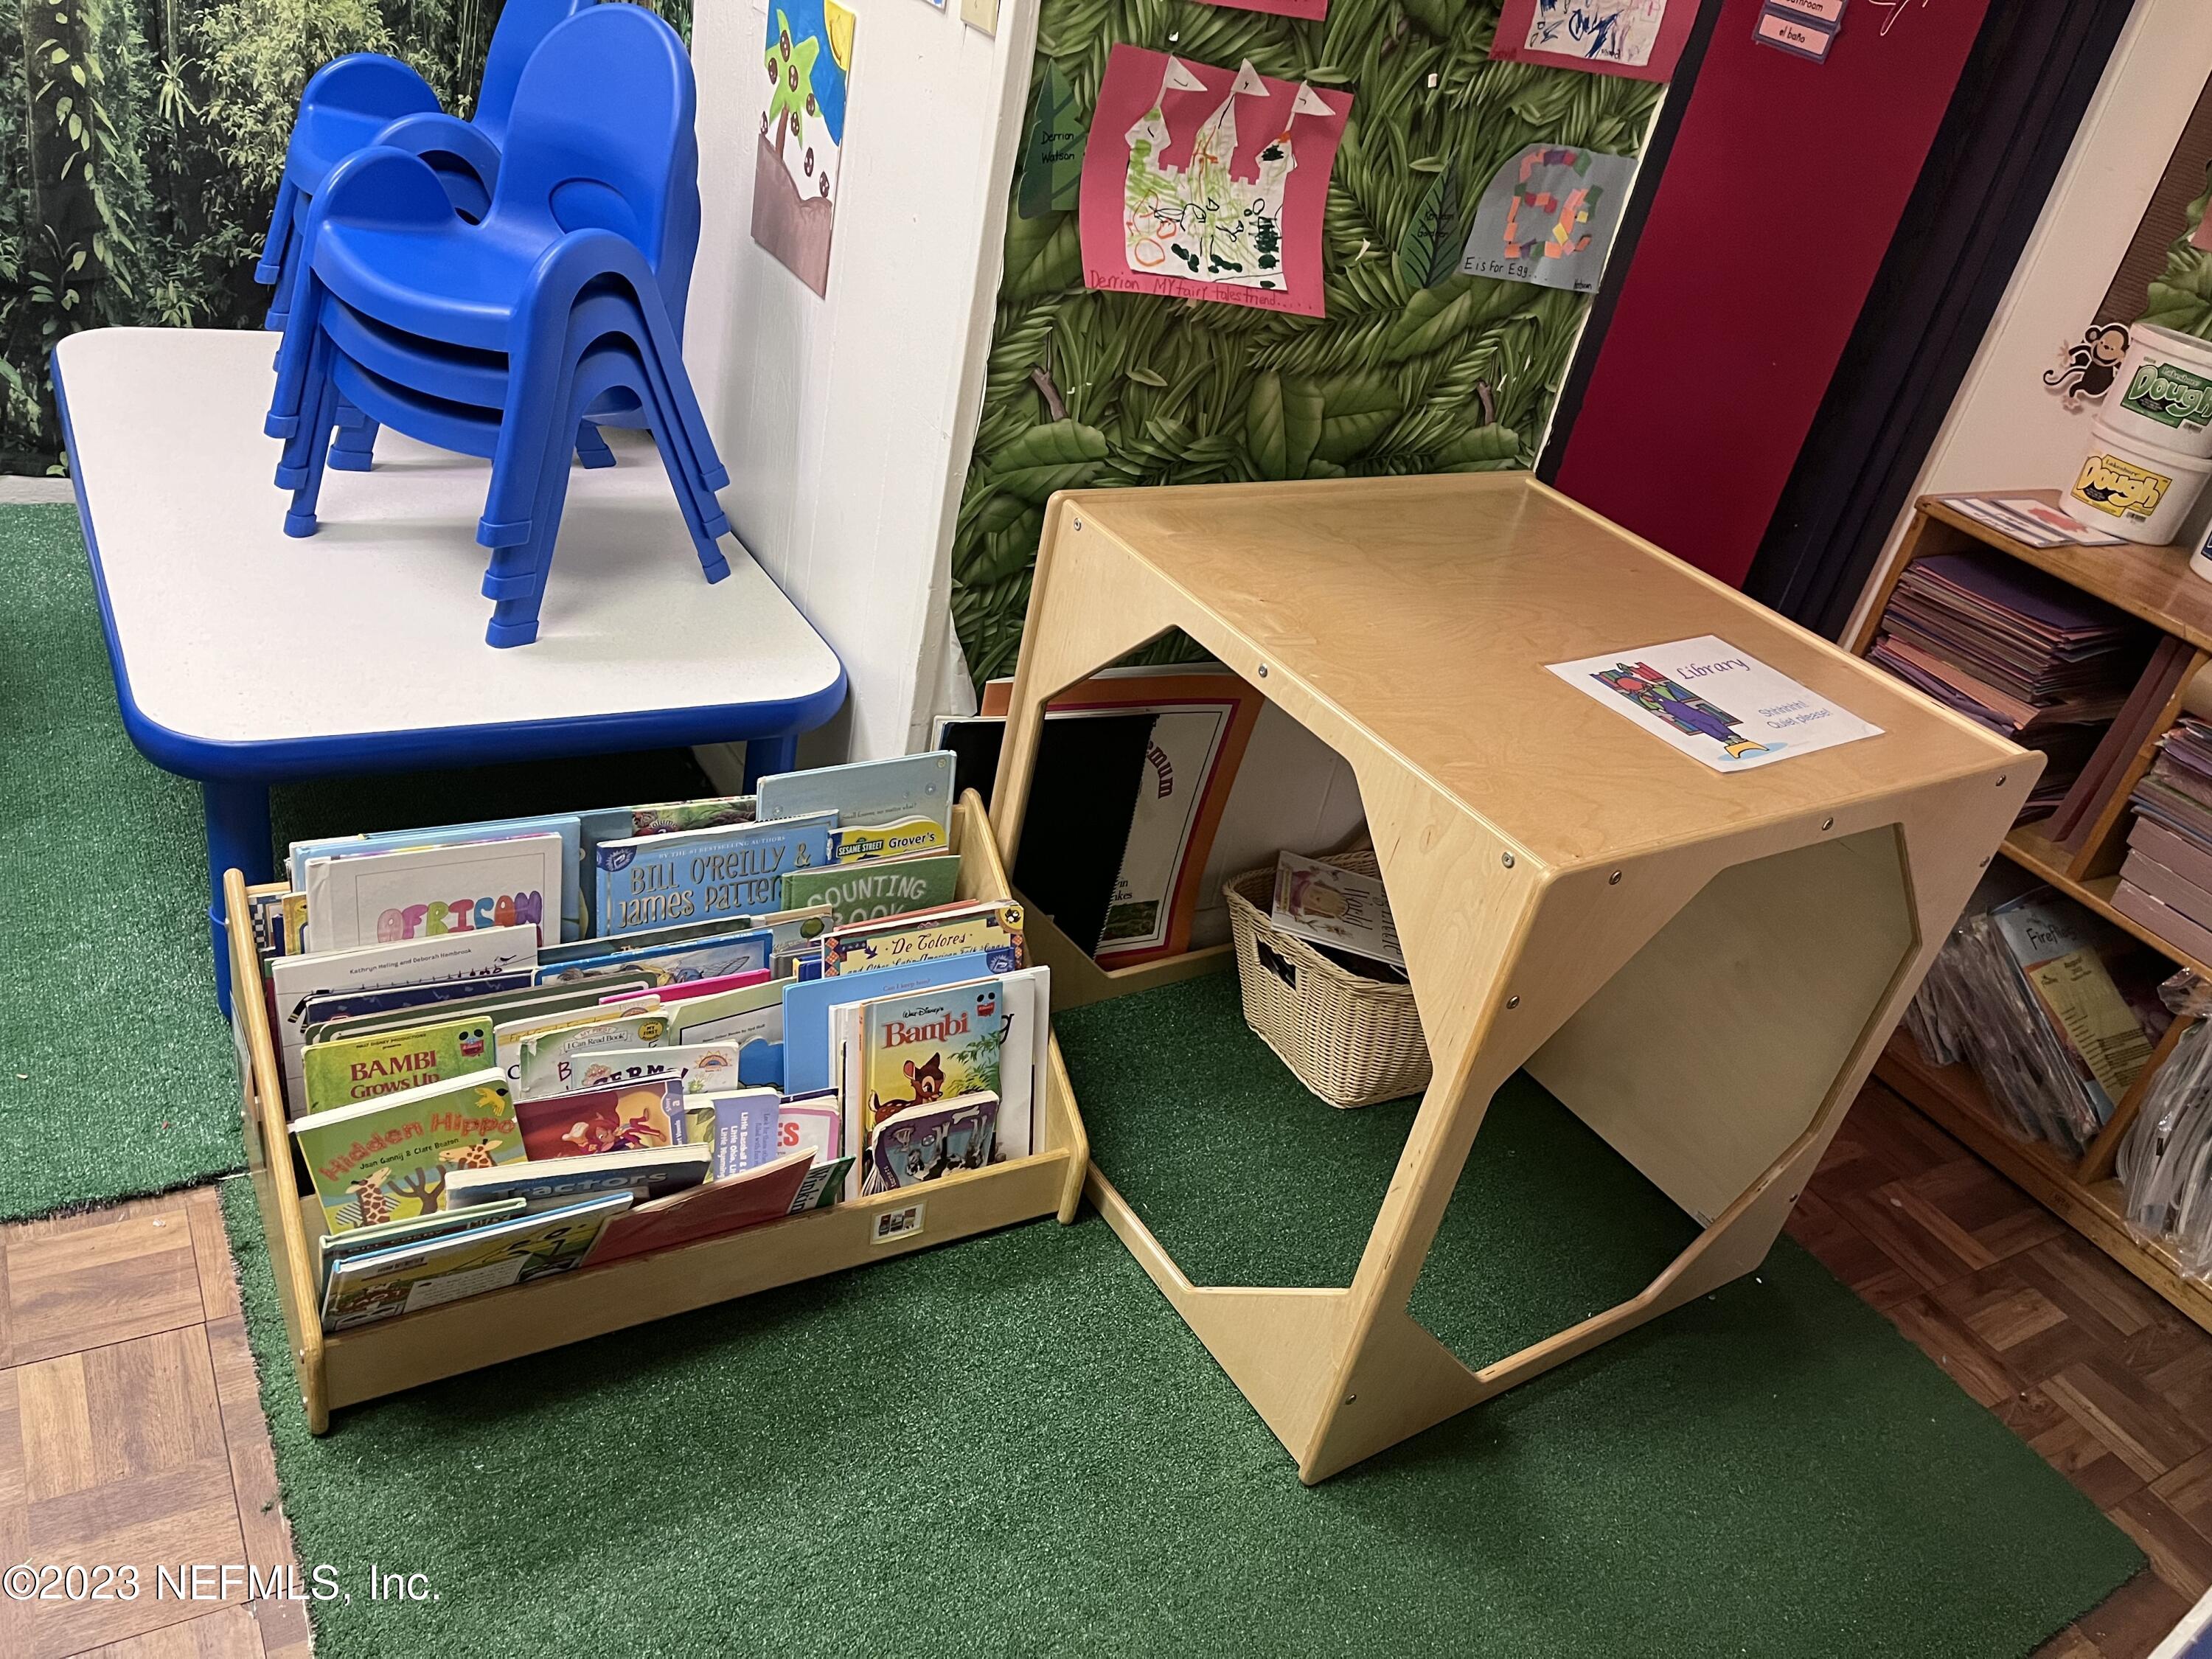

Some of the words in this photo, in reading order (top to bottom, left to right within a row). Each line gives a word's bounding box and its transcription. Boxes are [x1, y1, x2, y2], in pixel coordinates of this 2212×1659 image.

[1779, 25, 1788, 36] el
[1041, 131, 1074, 145] Derrion
[1041, 150, 1075, 164] Watson
[1464, 257, 1475, 270] E
[1475, 261, 1486, 272] is
[1090, 270, 1140, 291] Derrion
[2076, 456, 2160, 508] Dough
[1676, 658, 1751, 679] Library
[1767, 715, 1796, 729] Quiet
[1797, 708, 1834, 726] please!
[699, 841, 749, 853] BESTSELLING
[752, 835, 785, 845] AUTHORS
[838, 846, 862, 856] SESAME
[862, 841, 883, 853] STREET
[888, 832, 935, 849] Grover's
[630, 861, 680, 896] BILL
[793, 843, 810, 868] &
[807, 874, 927, 908] COUNTING
[377, 890, 543, 944] AFRICAN
[1342, 888, 1374, 931] World
[891, 936, 913, 956] De
[2025, 923, 2079, 950] Fireflies
[349, 964, 378, 975] Kathryn
[378, 960, 399, 970] Heling
[400, 958, 412, 966] and
[413, 953, 439, 963] Deborah
[370, 1039, 389, 1047] DISNEY
[391, 1032, 426, 1043] PRODUCTIONS
[881, 1011, 971, 1049] Bambi
[571, 1040, 586, 1048] Can
[588, 1037, 605, 1046] Read
[350, 1049, 437, 1082] BAMBI
[350, 1078, 411, 1099] Grows
[740, 1112, 748, 1130] Little
[720, 1127, 728, 1145] Little
[730, 1126, 739, 1143] Little
[318, 1121, 424, 1182] Hidden
[429, 1111, 516, 1138] Hippo
[414, 1144, 433, 1155] Clare
[434, 1138, 459, 1149] Beaton
[492, 1172, 668, 1200] Tractors
